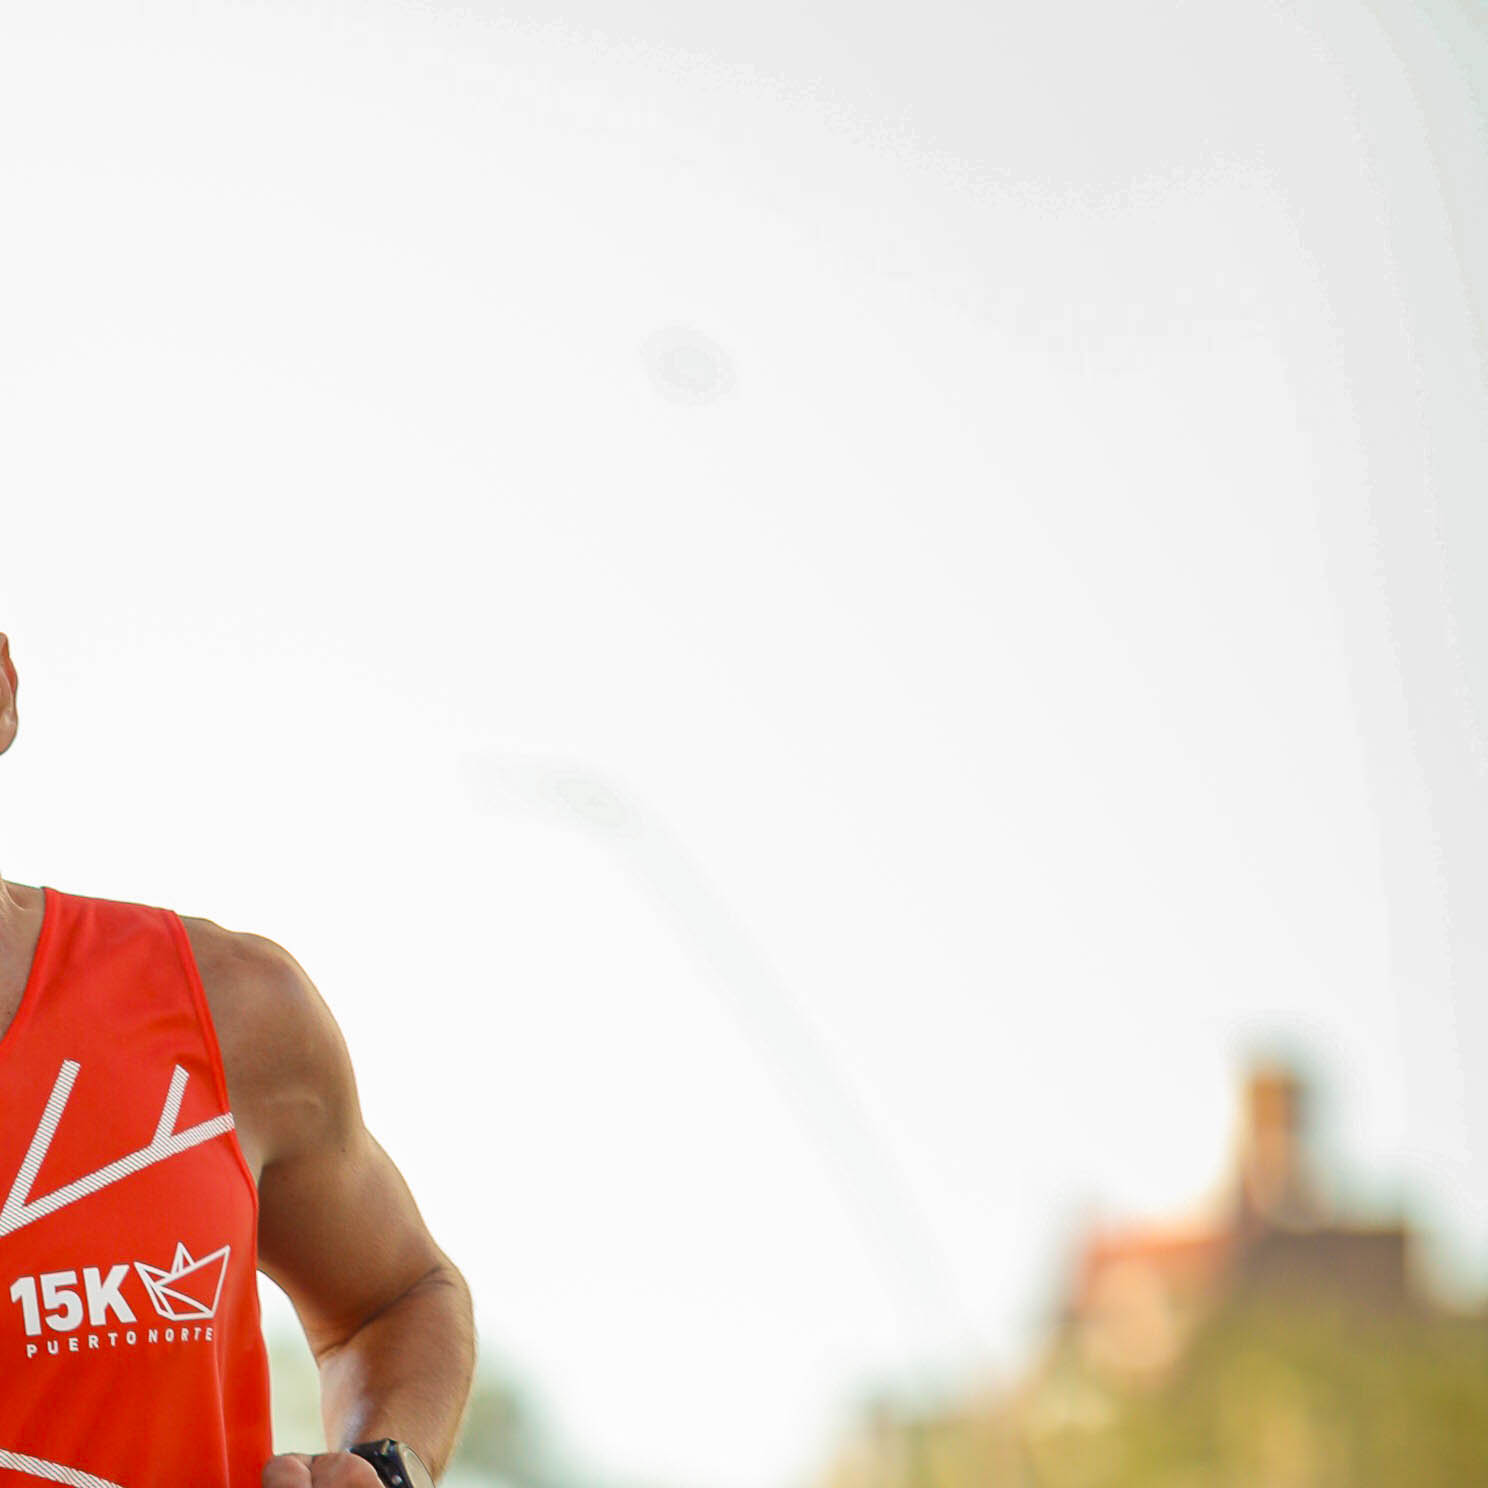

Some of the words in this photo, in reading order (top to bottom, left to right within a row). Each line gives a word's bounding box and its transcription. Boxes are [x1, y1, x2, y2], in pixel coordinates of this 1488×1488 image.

[10, 1264, 137, 1336] 15K
[26, 1331, 137, 1358] PUERTO
[148, 1327, 213, 1343] NORTE
